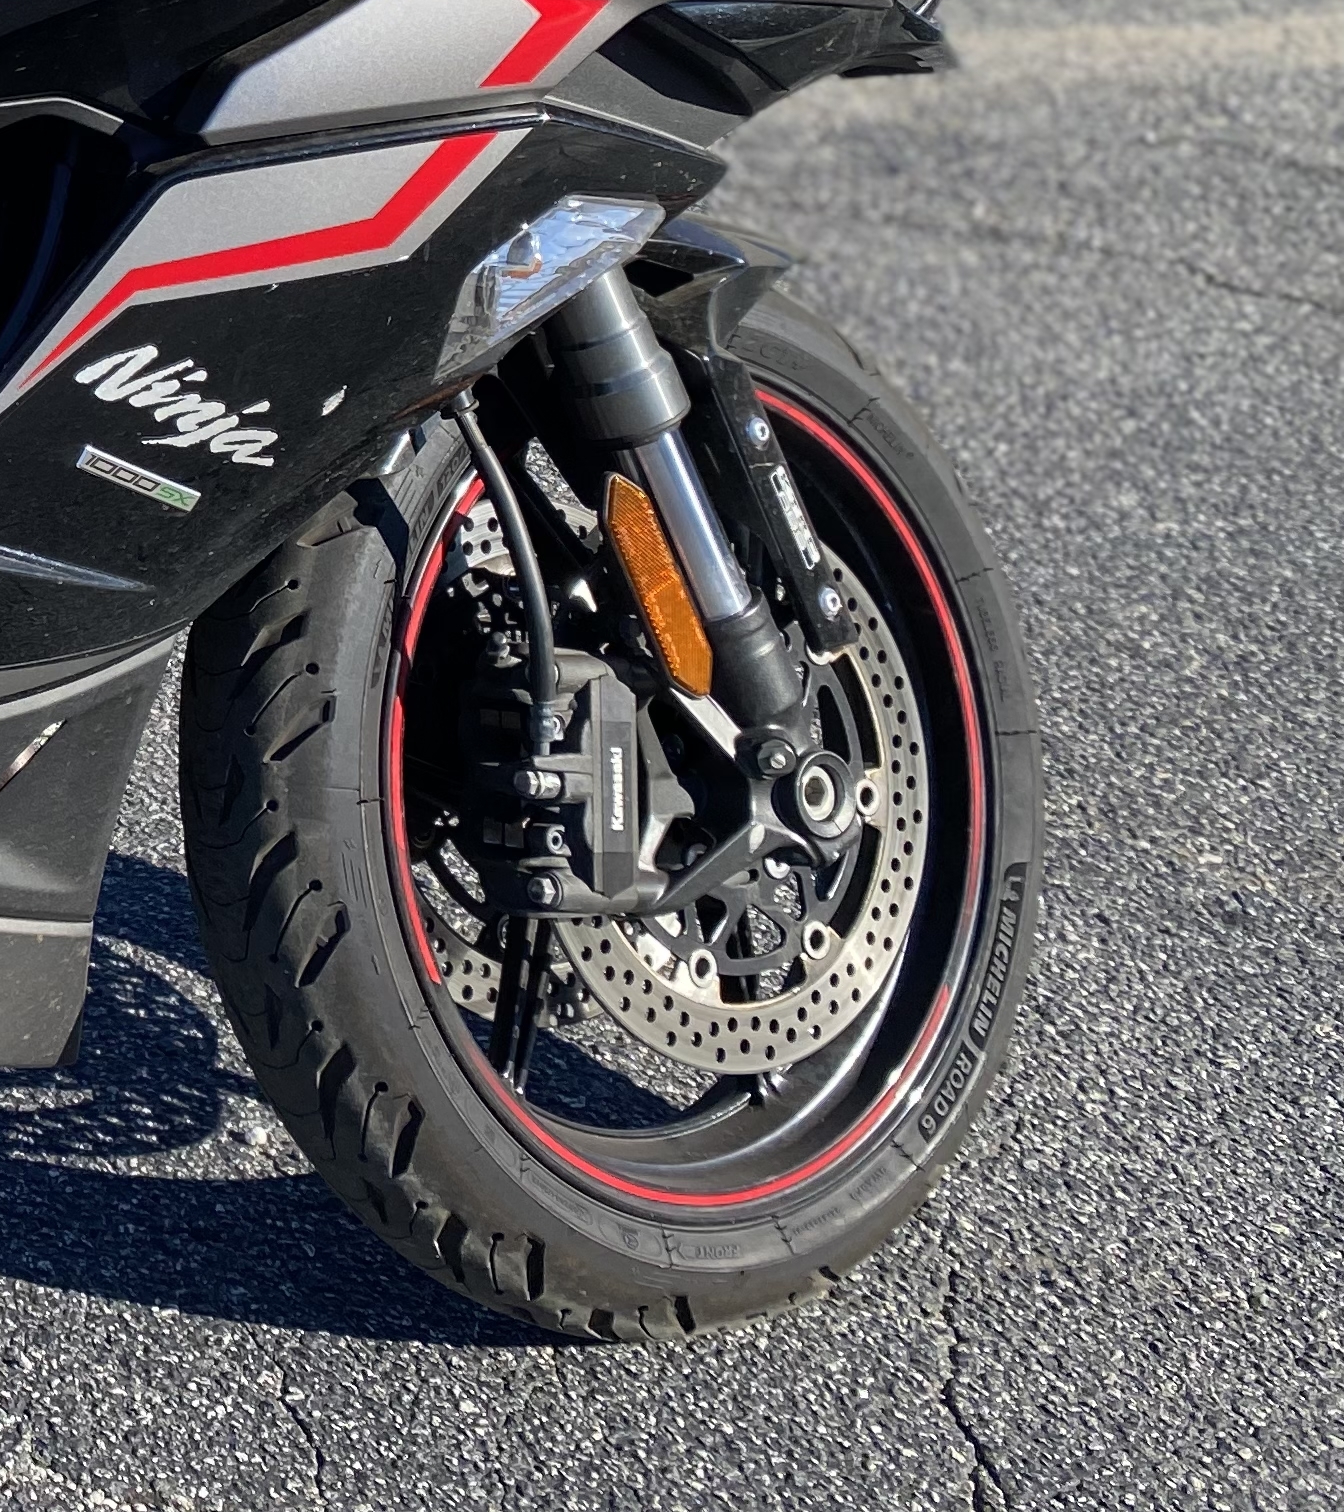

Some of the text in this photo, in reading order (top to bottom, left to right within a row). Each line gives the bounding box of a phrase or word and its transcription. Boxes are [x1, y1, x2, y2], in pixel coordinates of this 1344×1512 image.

[74, 343, 279, 467] Ninja
[610, 746, 624, 831] Kawasaki
[972, 906, 1017, 1038] MICHELIN
[921, 1049, 973, 1133] ROAD 6
